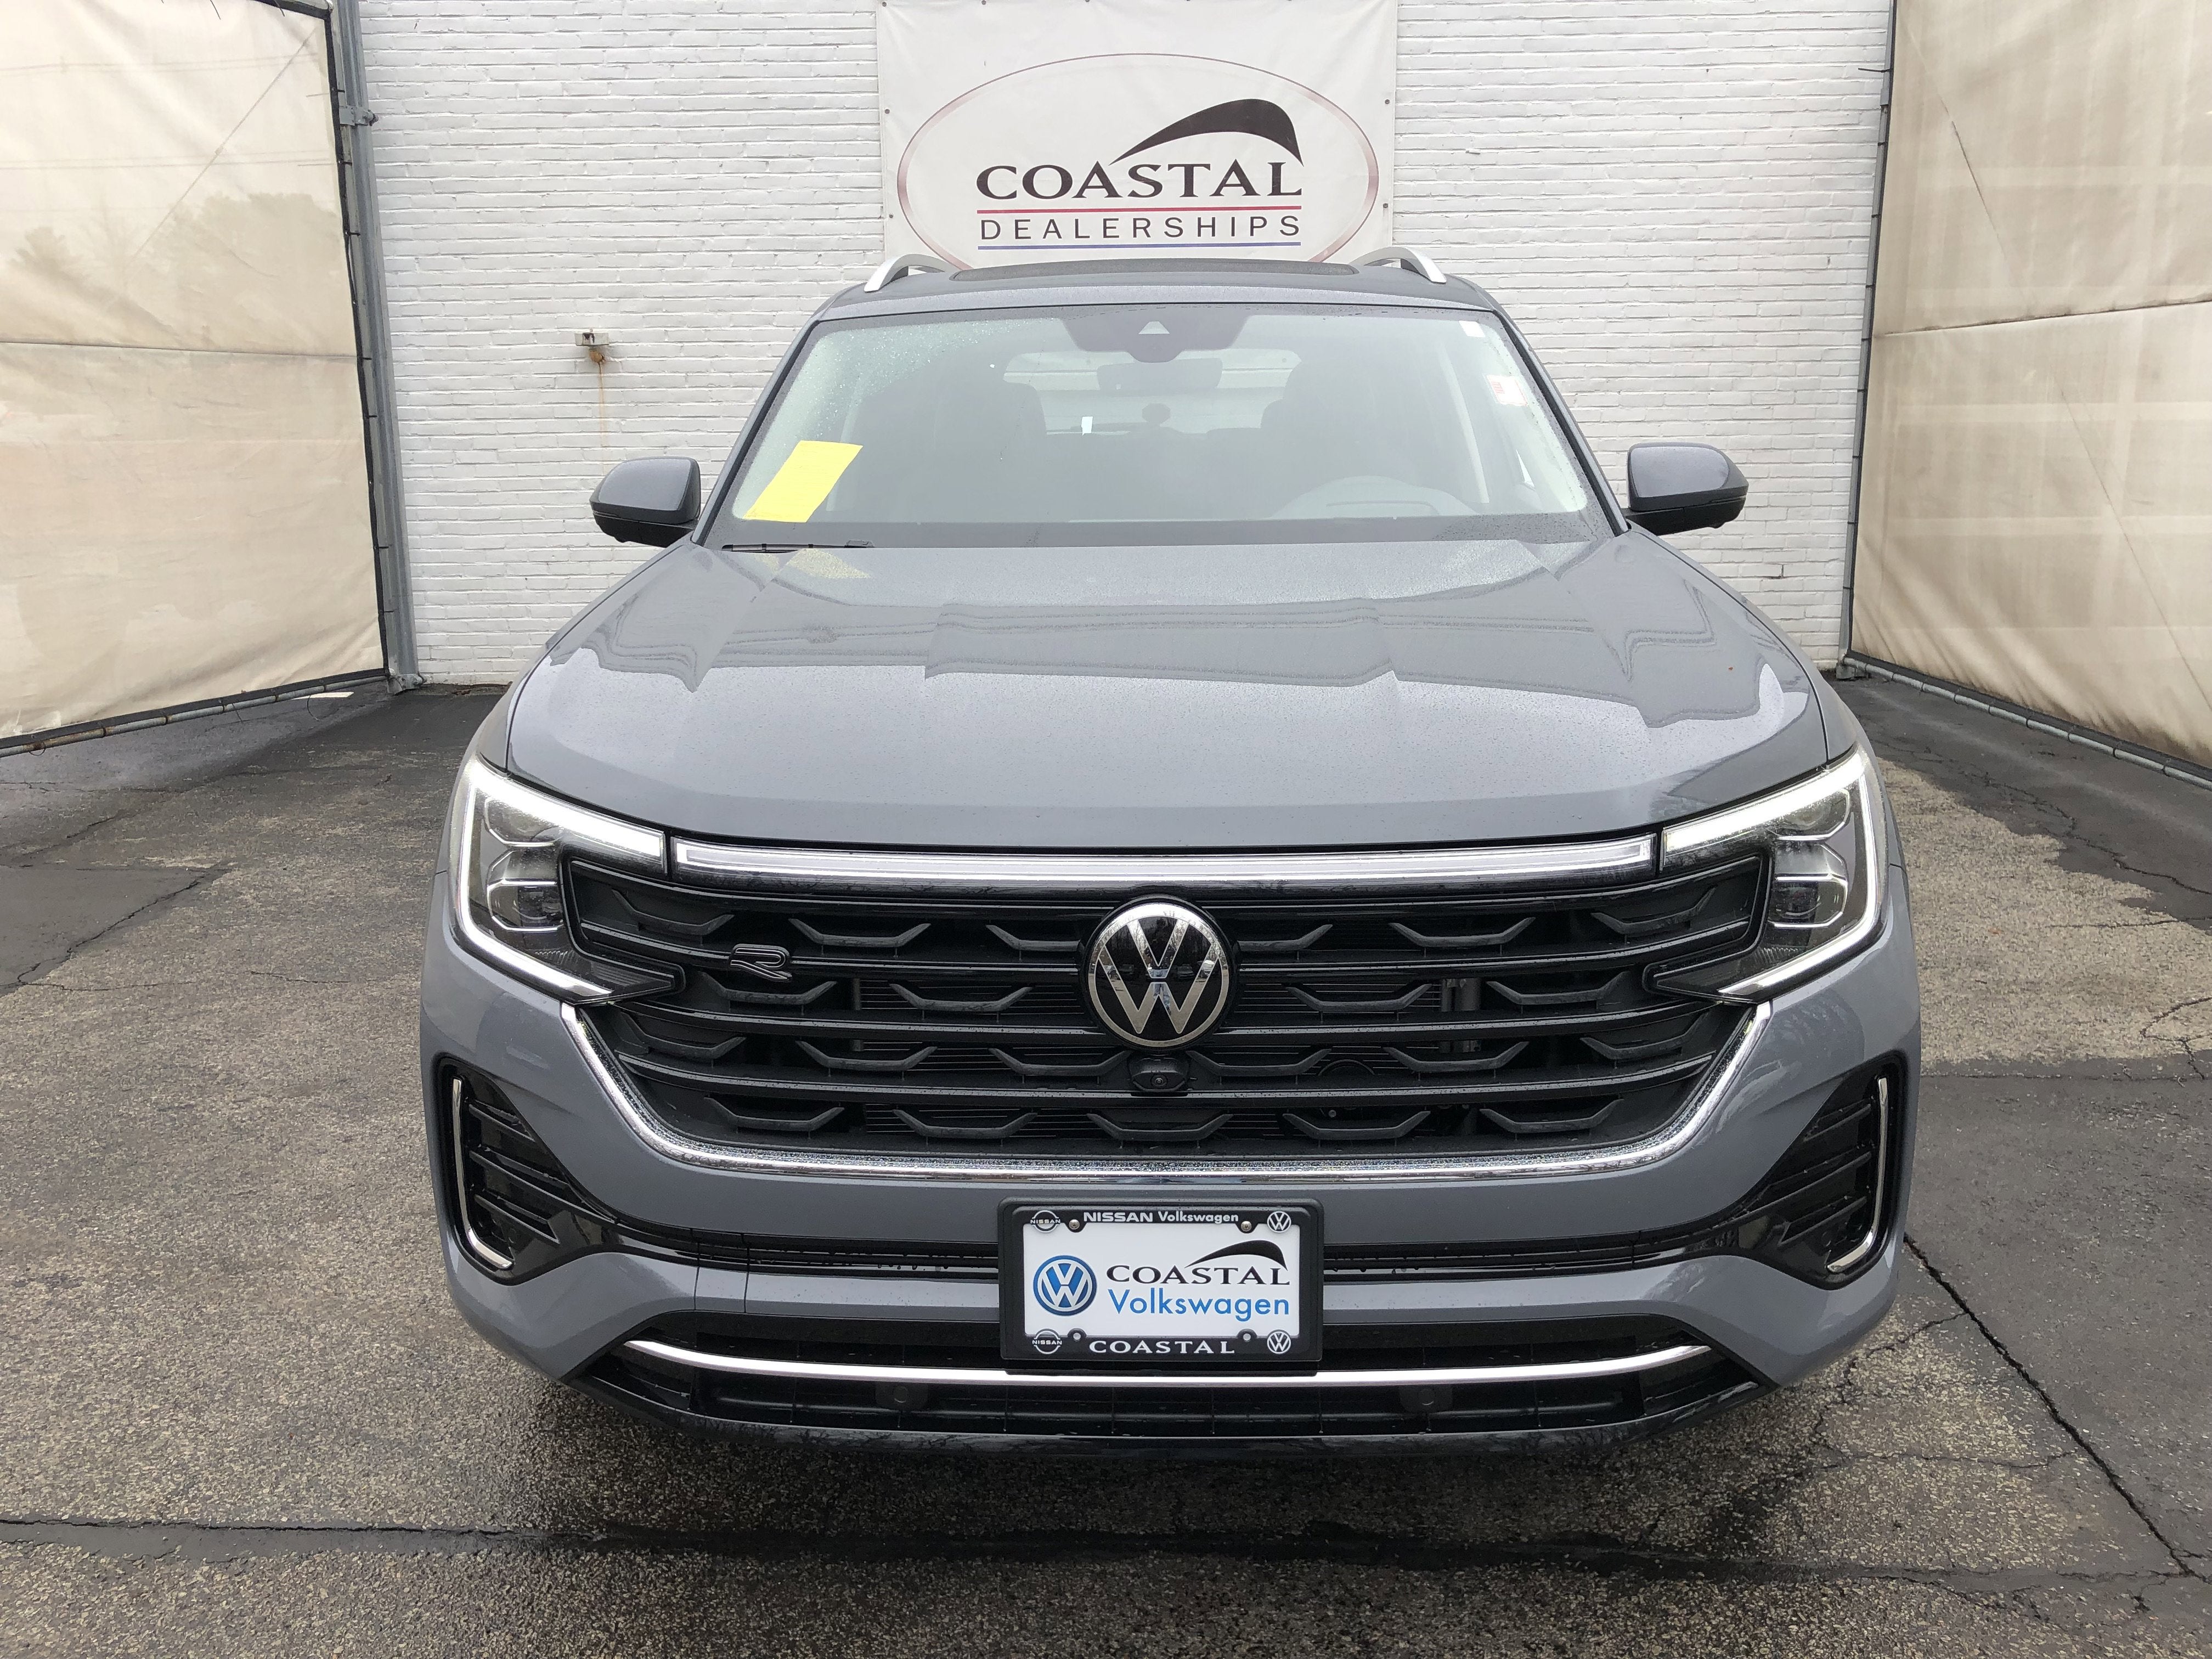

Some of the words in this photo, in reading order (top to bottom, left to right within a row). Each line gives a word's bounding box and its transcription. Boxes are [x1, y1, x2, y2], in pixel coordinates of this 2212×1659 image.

[976, 159, 1302, 200] COASTAL
[980, 215, 1301, 240] DEALERSHIPS
[1083, 1211, 1153, 1222] NISSAN
[1158, 1210, 1239, 1224] Volkswagen
[1106, 1264, 1290, 1285] COASTAL
[1107, 1287, 1290, 1322] Volkswagen
[1088, 1340, 1235, 1354] COASTAL
